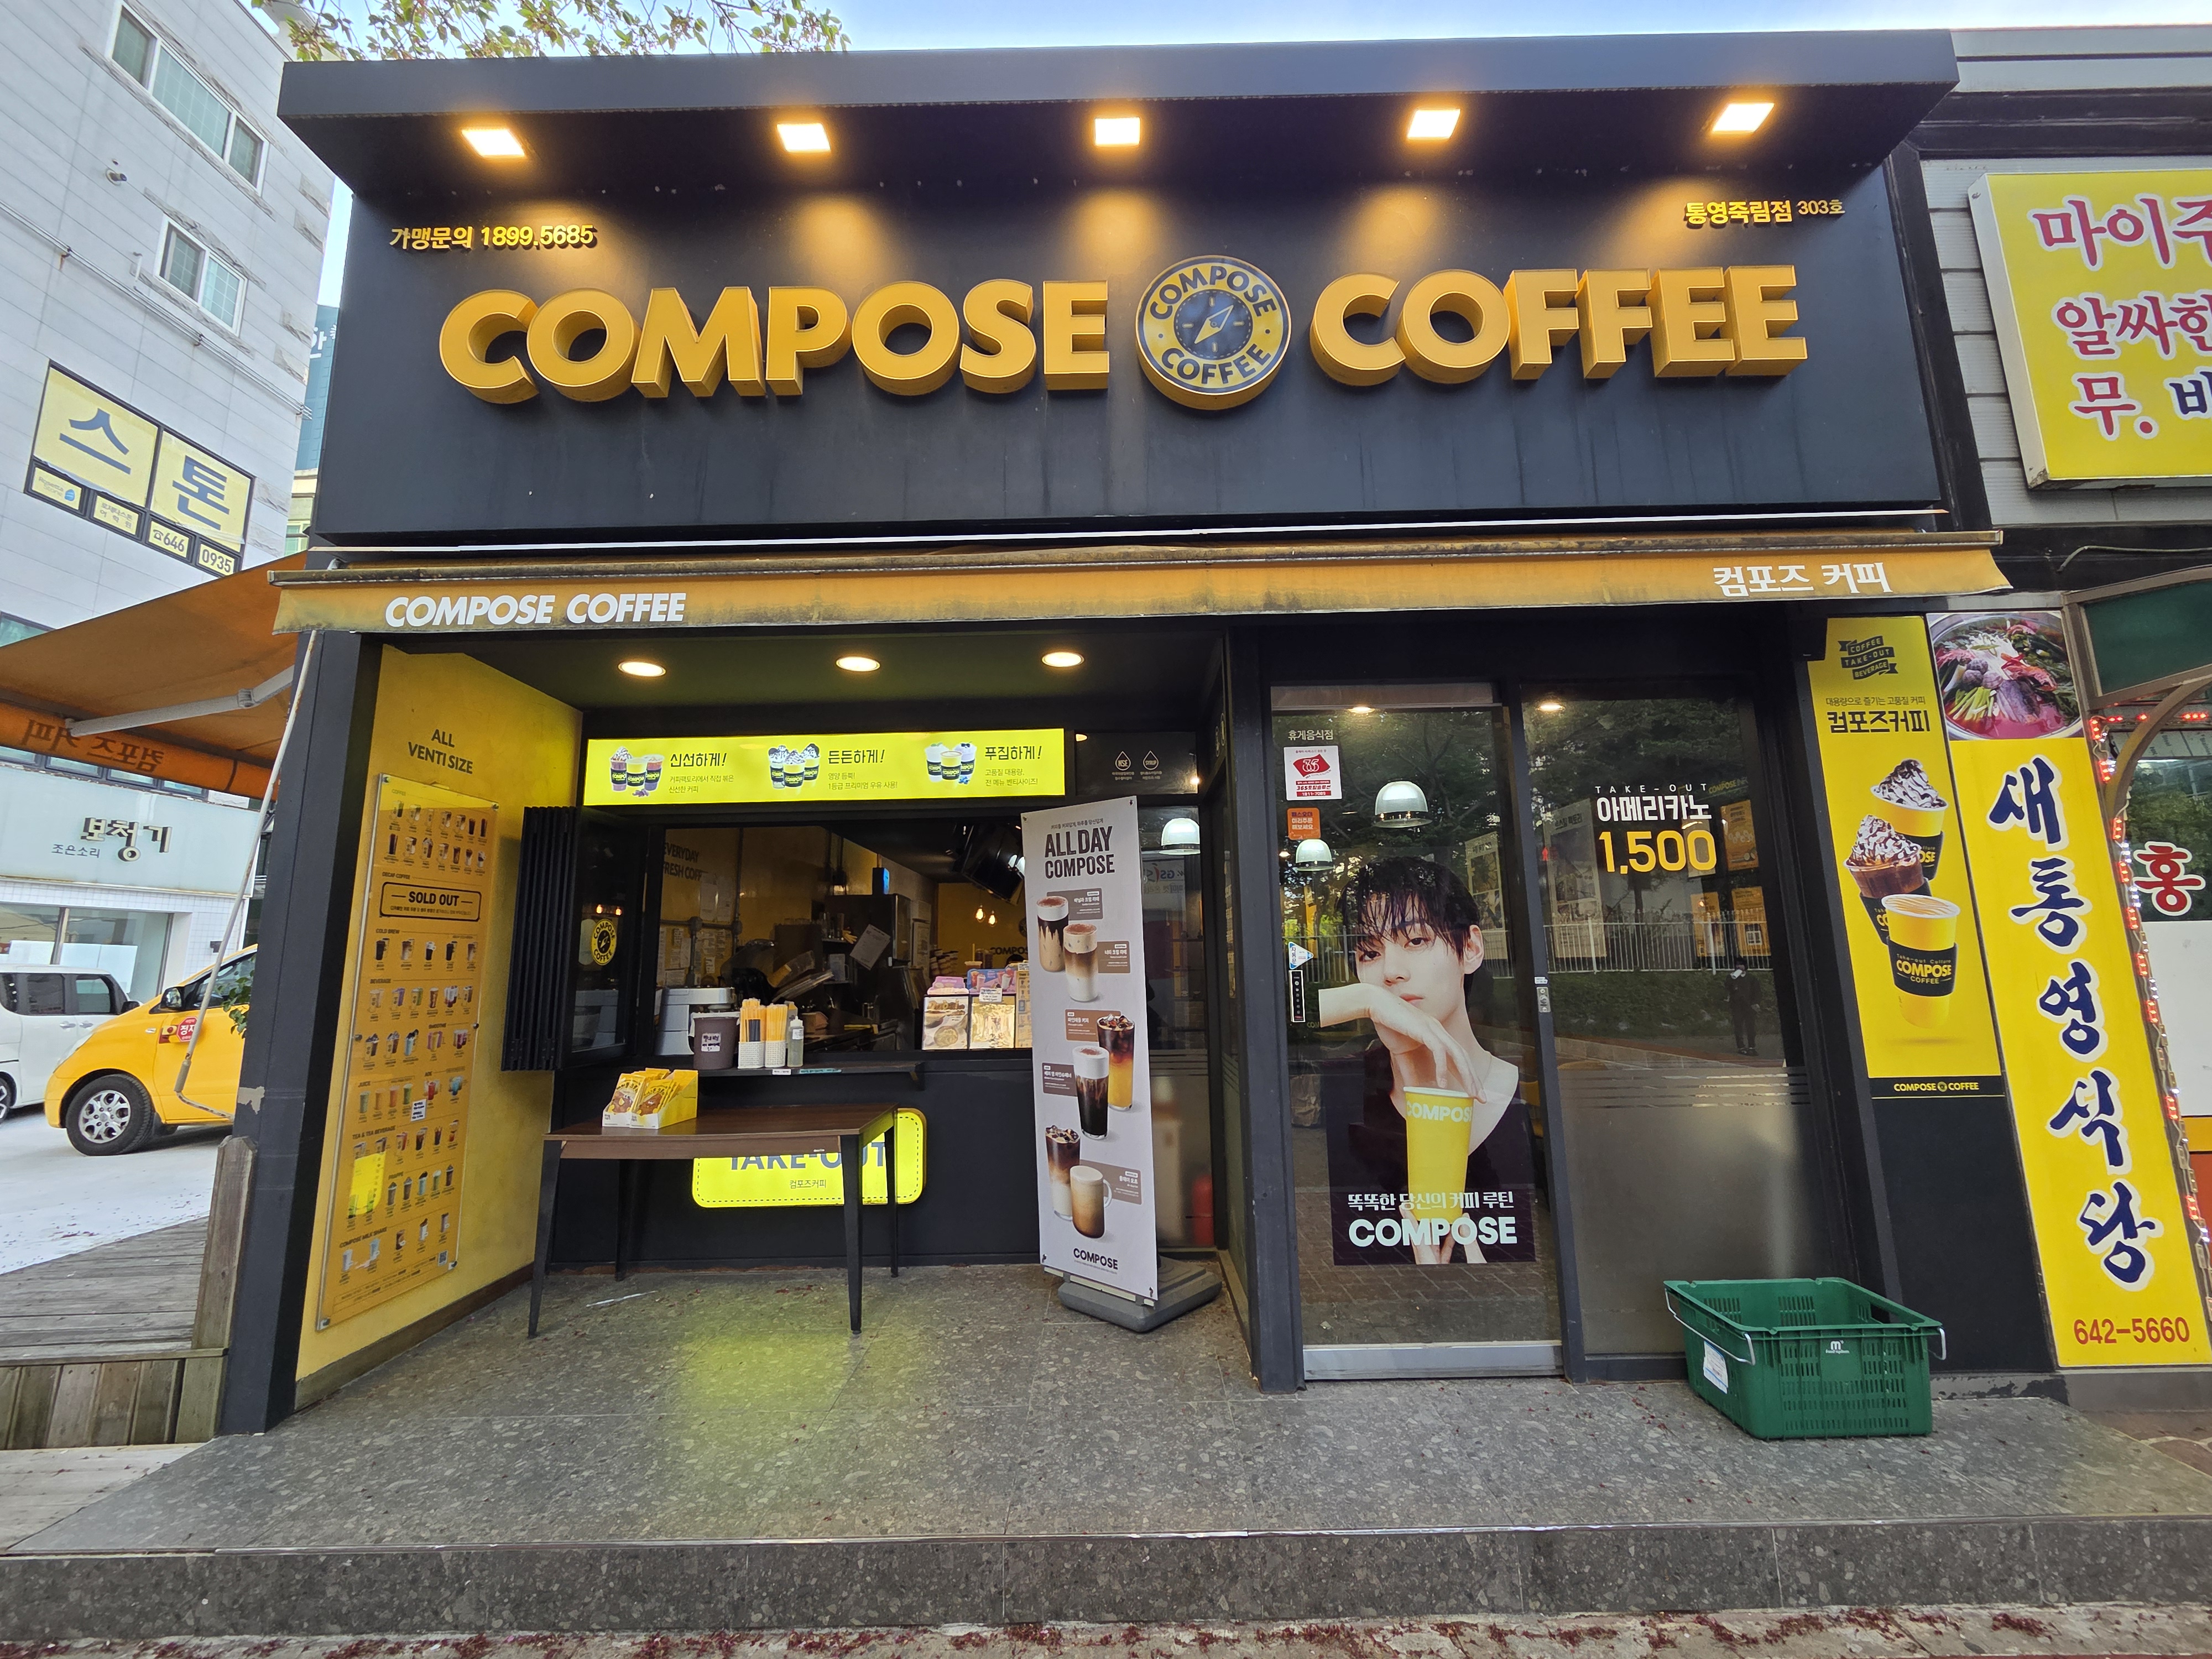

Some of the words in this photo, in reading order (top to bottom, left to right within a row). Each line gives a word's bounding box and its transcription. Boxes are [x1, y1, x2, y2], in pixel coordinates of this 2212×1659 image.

[1686, 200, 1792, 225] 통영죽림점
[1797, 199, 1845, 215] 303호
[389, 226, 473, 250] 가맹문의
[481, 224, 595, 247] 1899.5685
[1150, 265, 1277, 320] COMPOSE
[440, 278, 1110, 404] COMPOSE
[1311, 265, 1807, 386] COFFEE
[1161, 343, 1271, 384] COFFEE
[59, 408, 229, 531] 스톤
[164, 532, 185, 552] 646
[201, 549, 233, 573] 0935
[1713, 566, 1814, 597] 컴포즈
[1821, 562, 1893, 593] 커피
[385, 595, 555, 627] COMPOSE
[567, 593, 686, 623] COFFEE
[1850, 638, 1881, 653] COFFEE
[1844, 648, 1890, 667] TAKE-OUT
[1854, 662, 1888, 677] BEVERAGE
[1825, 697, 1862, 706] 대용량으로
[1863, 697, 1885, 706] 즐기는
[1887, 696, 1909, 706] 고품질
[1910, 696, 1926, 705] 커피
[1827, 710, 1931, 733] 컴포즈커피
[431, 729, 455, 748] ALL
[1288, 729, 1334, 740] 휴게음식점
[408, 742, 446, 766] VENTI
[448, 750, 473, 774] SIZE
[670, 753, 727, 767] 신선하게!
[828, 749, 885, 764] 든든하게!
[984, 745, 1042, 760] 푸짐하게!
[1595, 783, 1707, 794] TAKE-OUT
[1597, 795, 1712, 822] 아메리카노
[82, 816, 173, 862] 보청기
[1045, 831, 1076, 858] ALL
[1078, 826, 1113, 854] DAY
[1045, 854, 1115, 879] COMPOSE
[2134, 844, 2201, 912] 홍
[408, 891, 436, 905] SOLD
[439, 894, 460, 906] OUT
[594, 922, 615, 939] COMPOSE
[594, 949, 612, 961] COFFEE
[1896, 959, 1952, 977] COMPOSE
[1910, 976, 1940, 984] COFFEE
[1990, 758, 2156, 1285] 새통영식당
[1894, 1083, 1937, 1092] COMPOSE
[1948, 1082, 1979, 1091] COFFEE
[731, 1142, 886, 1170] TAKE-T
[789, 1179, 827, 1189] 컴포즈커피
[1348, 1194, 1396, 1211] 똑똑한
[1399, 1192, 1447, 1210] 당신의
[1449, 1192, 1480, 1209] 커피
[1483, 1191, 1514, 1209] 루틴
[1349, 1217, 1517, 1247] COMPOSE
[1073, 1248, 1119, 1270] COMPOSE
[2074, 1317, 2190, 1345] 642-5660
